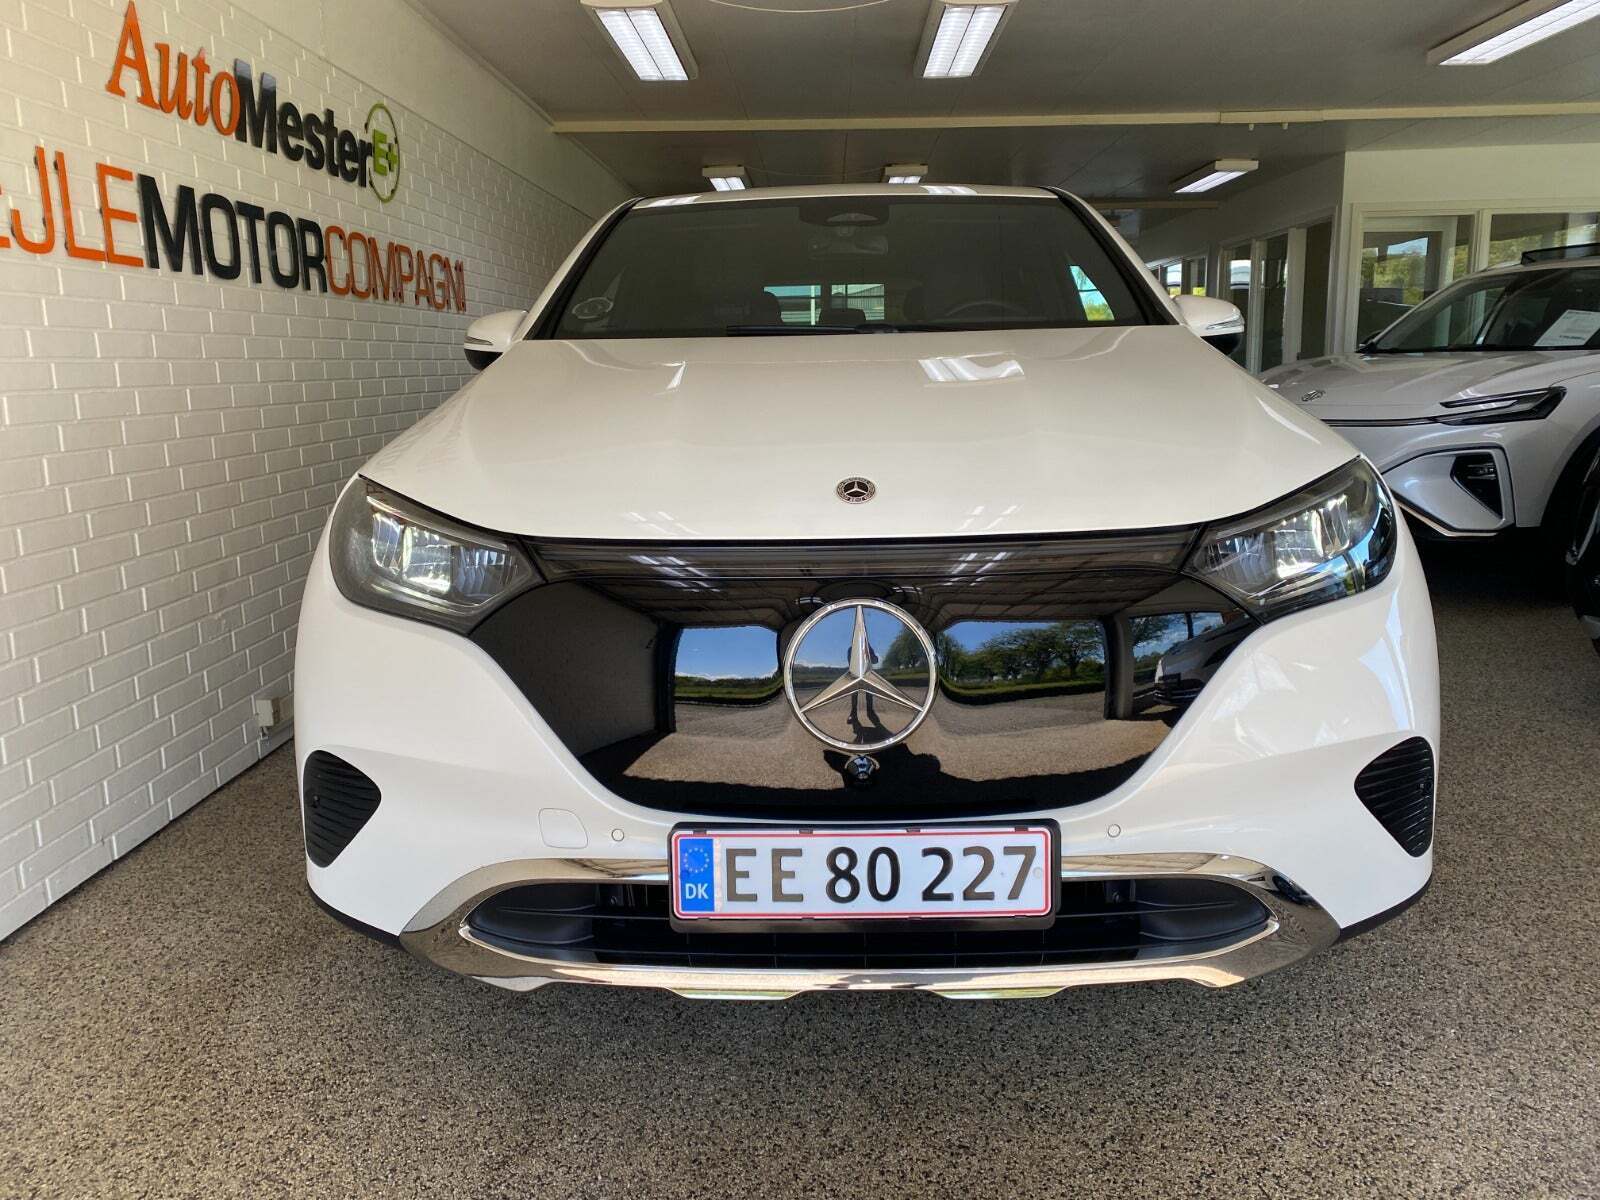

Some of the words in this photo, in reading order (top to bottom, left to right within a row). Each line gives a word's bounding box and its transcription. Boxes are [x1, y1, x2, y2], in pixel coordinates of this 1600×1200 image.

[0, 146, 466, 313] JLEMOTORCOMPAGNI
[685, 883, 709, 899] DK
[726, 848, 804, 903] EE
[825, 846, 901, 904] 80
[921, 845, 1037, 902] 227
